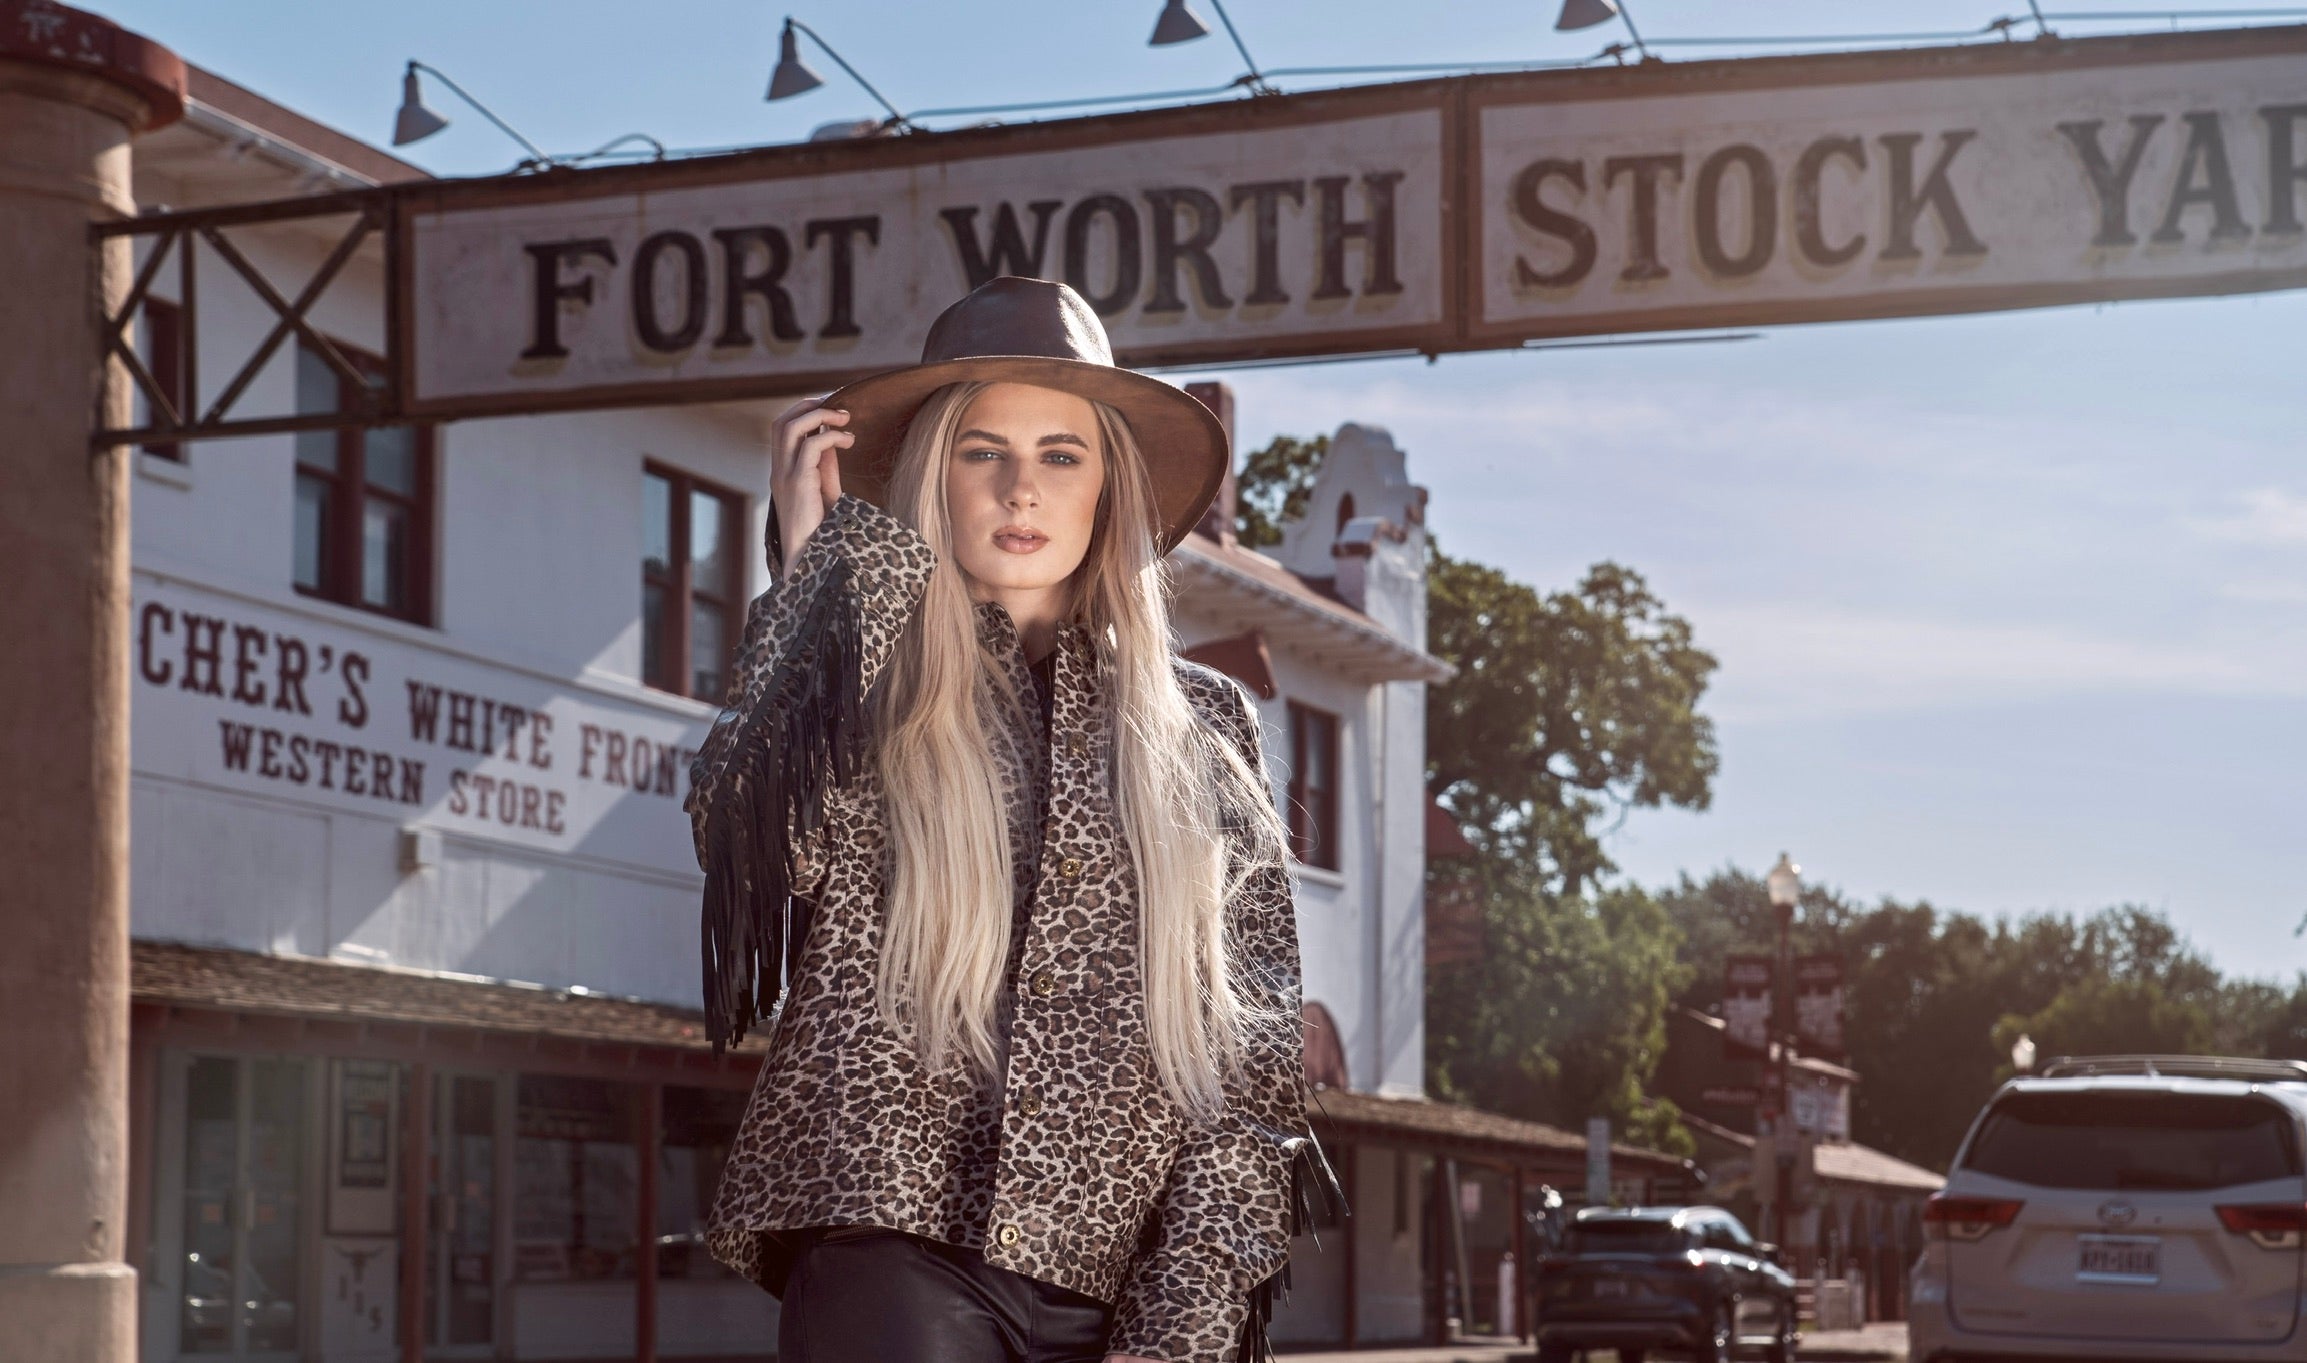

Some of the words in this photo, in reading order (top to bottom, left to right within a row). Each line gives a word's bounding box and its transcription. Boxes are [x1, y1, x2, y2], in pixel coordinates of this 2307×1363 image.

[521, 214, 881, 361] FORT
[940, 171, 1405, 320] WORTH
[1513, 129, 1988, 289] STOCK
[218, 720, 426, 806] WESTERN
[449, 768, 566, 836] STORE
[405, 680, 554, 770] WHITE
